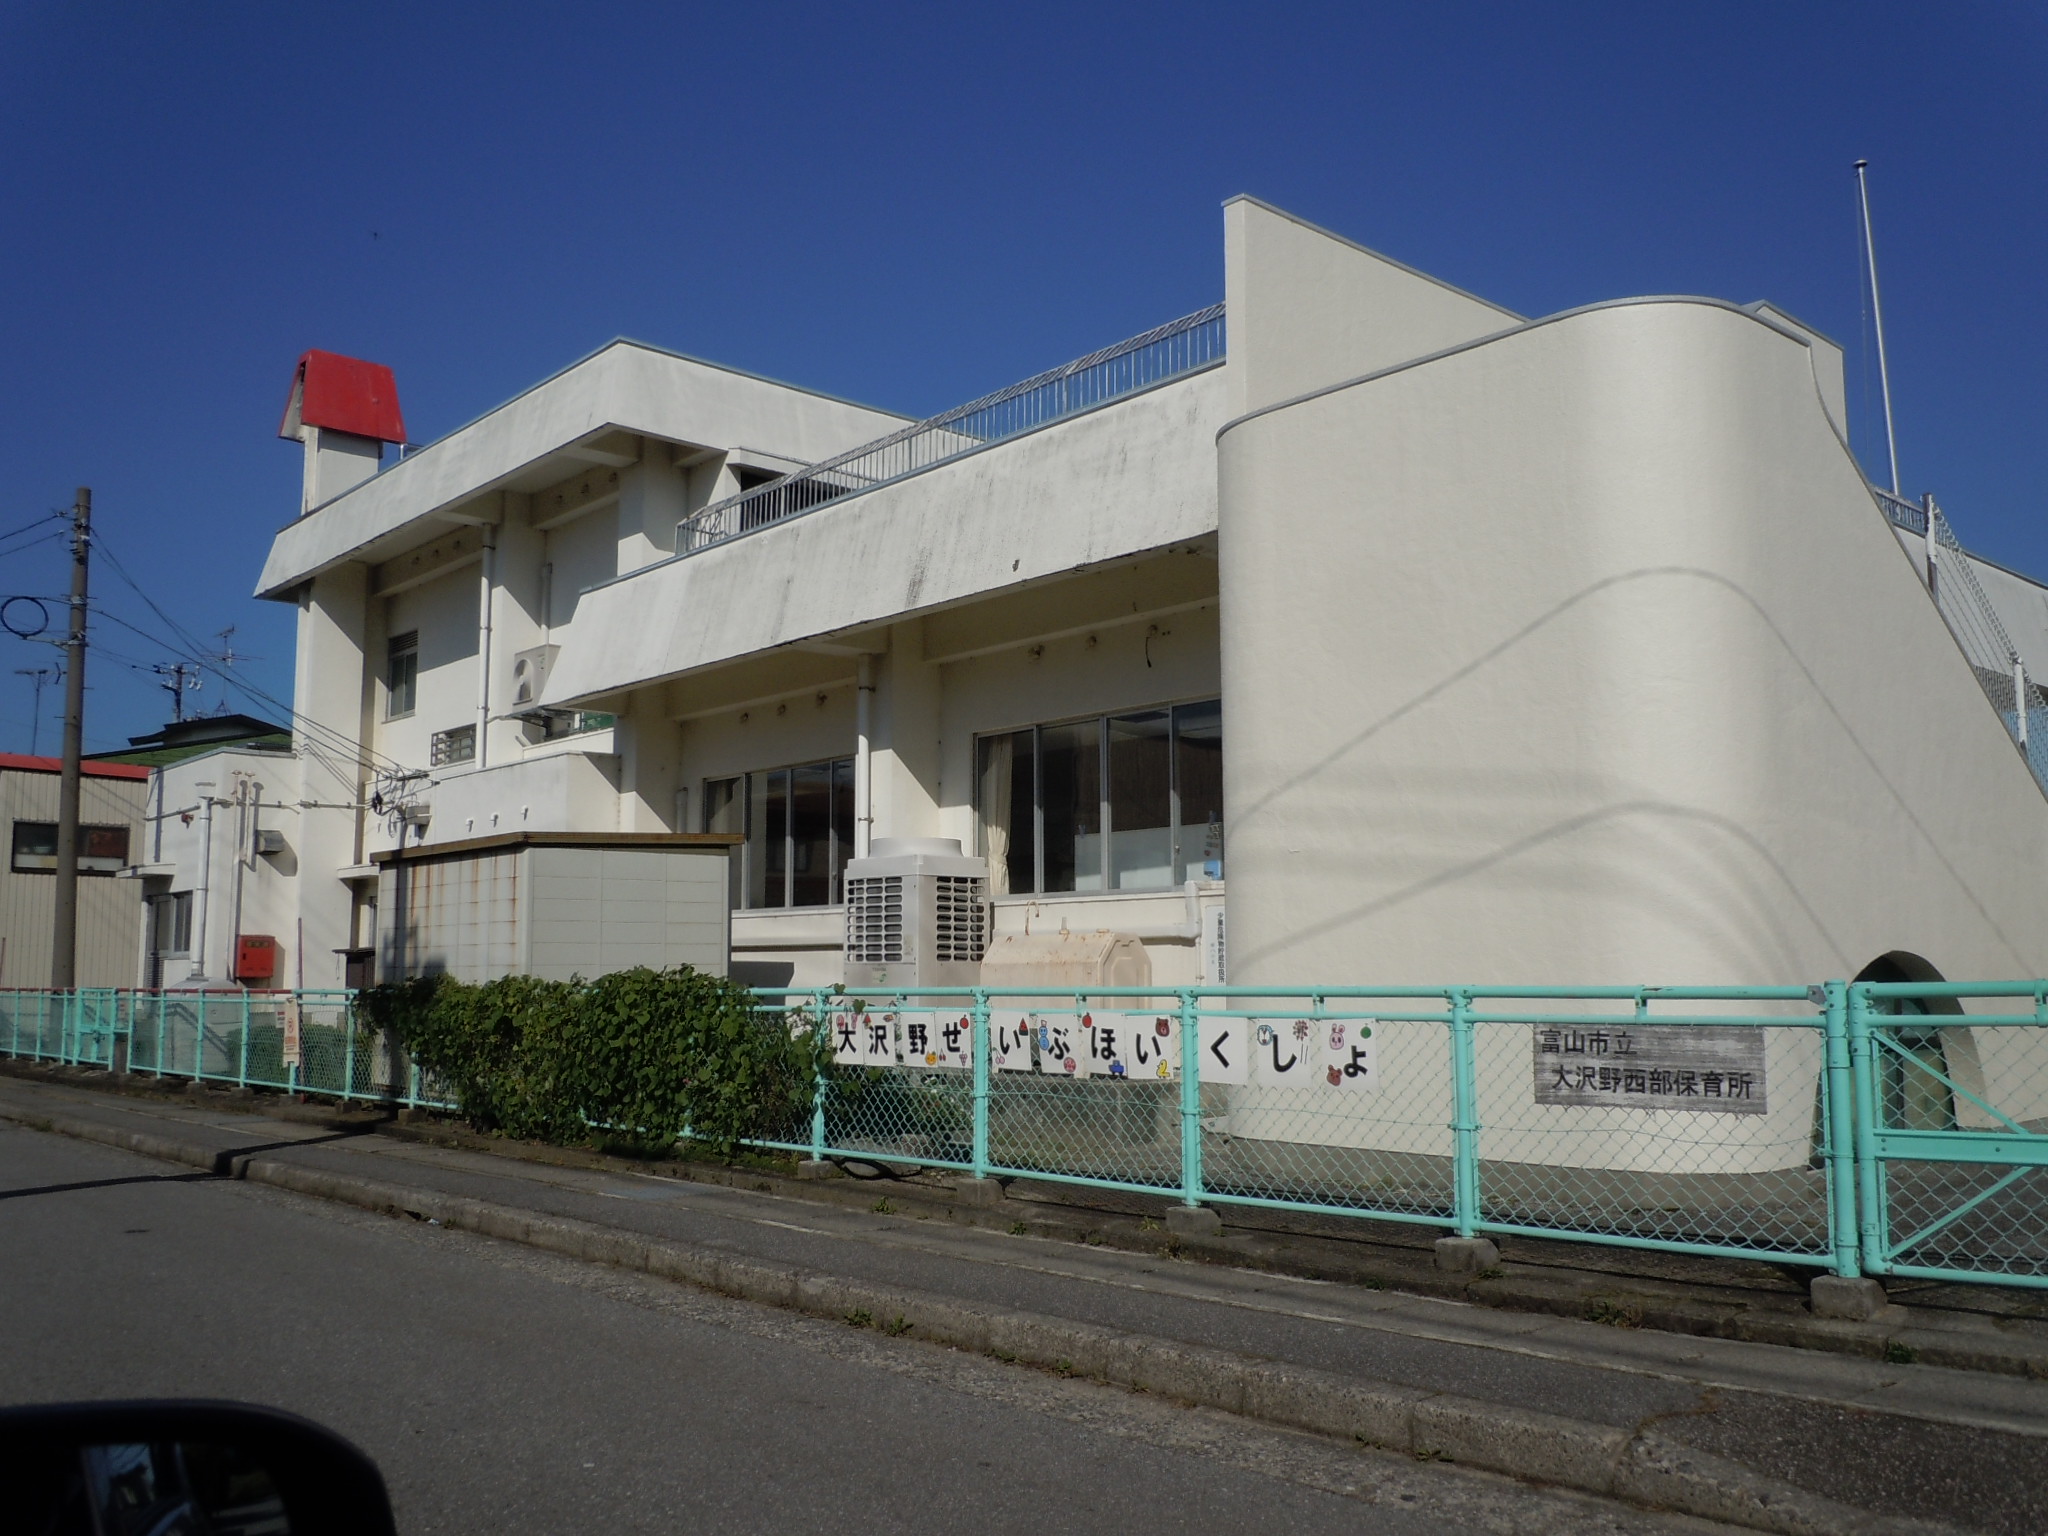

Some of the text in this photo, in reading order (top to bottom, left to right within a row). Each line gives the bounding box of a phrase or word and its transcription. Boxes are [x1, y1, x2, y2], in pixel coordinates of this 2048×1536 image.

[1539, 1028, 1638, 1056] 富山市立
[1551, 1064, 1754, 1100] 大沢野西部保育所
